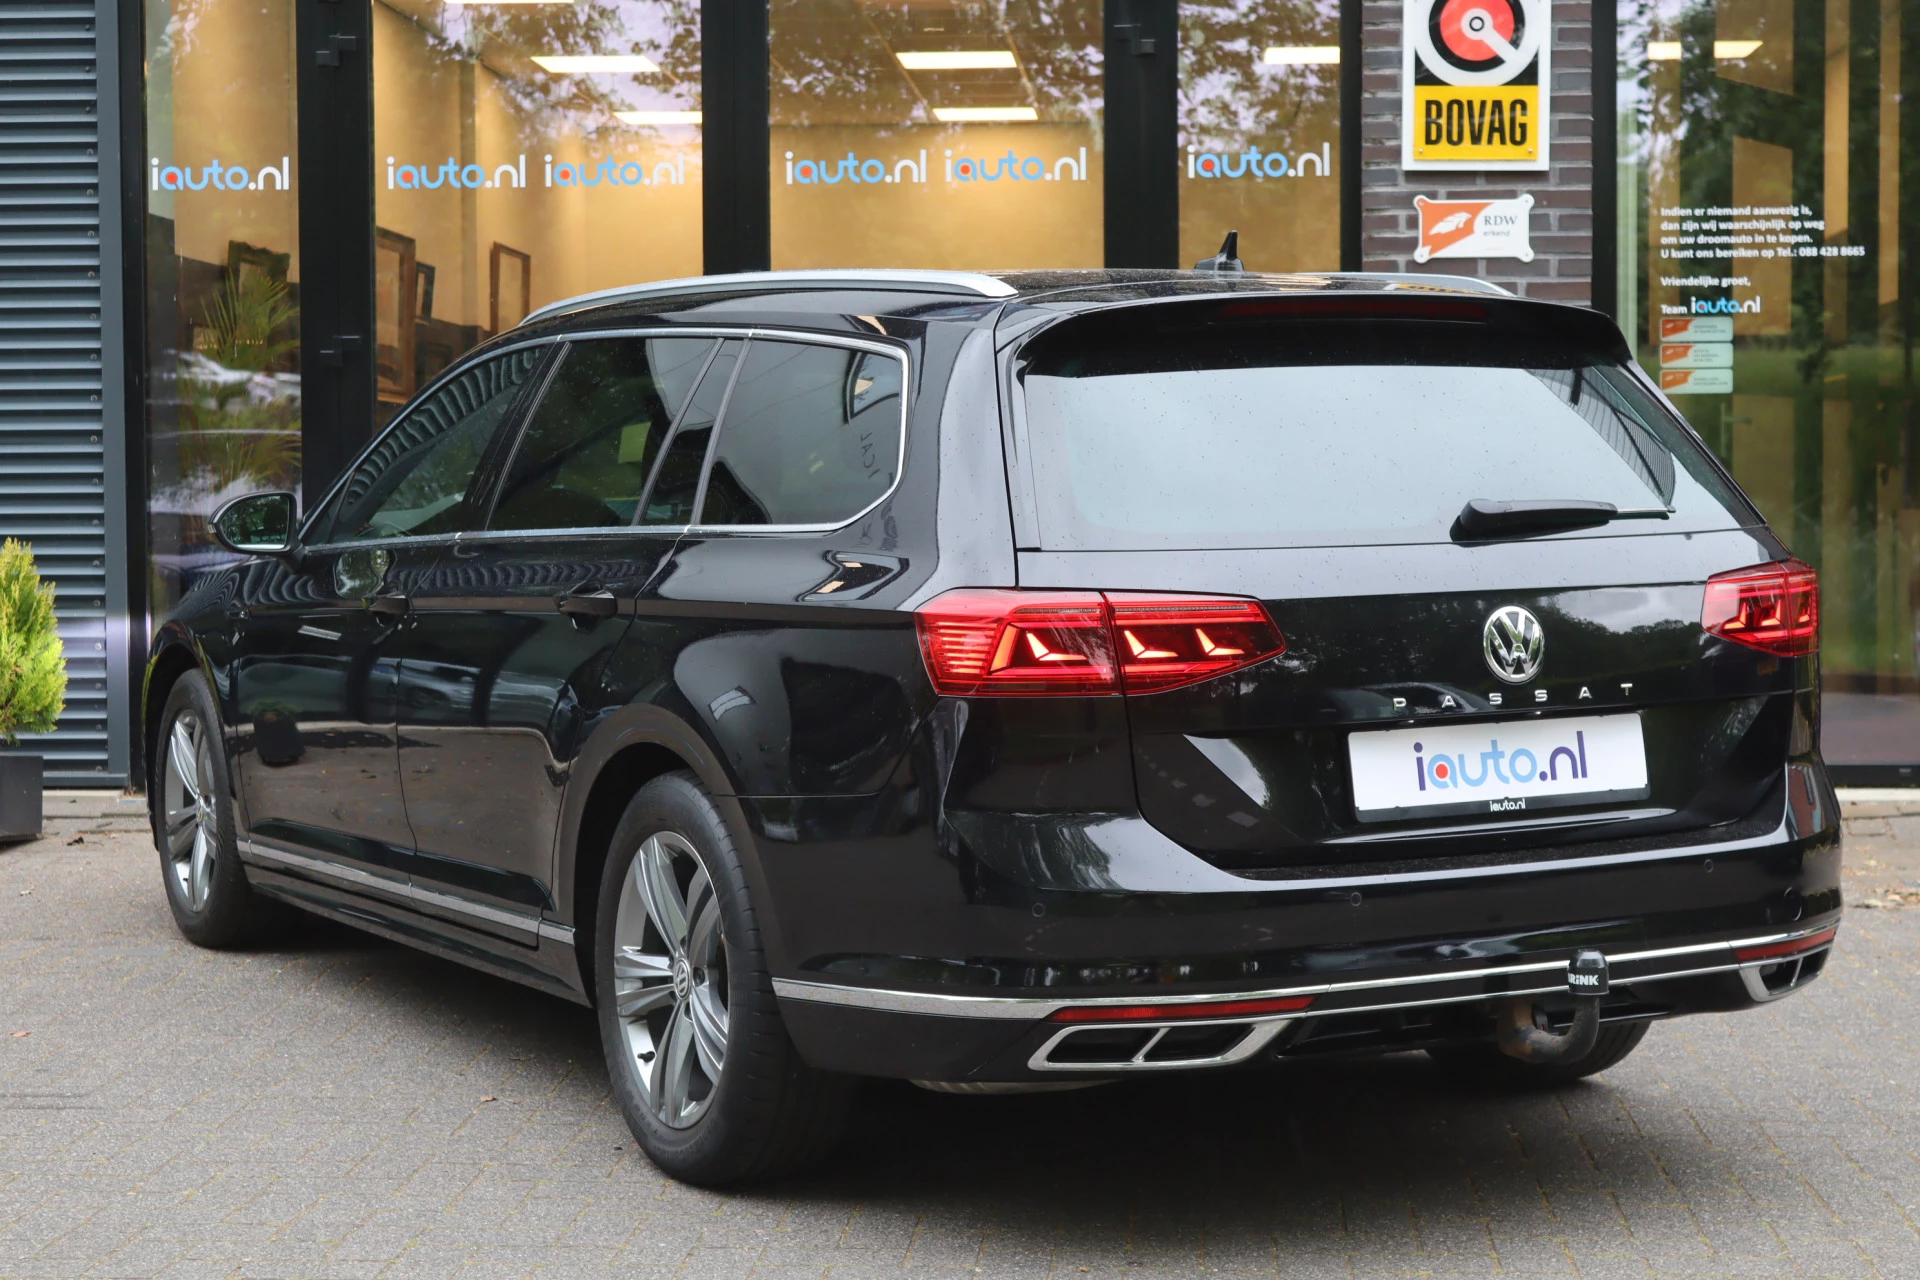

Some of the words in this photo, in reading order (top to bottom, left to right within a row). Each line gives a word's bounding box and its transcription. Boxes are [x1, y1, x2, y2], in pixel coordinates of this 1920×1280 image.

[1425, 99, 1528, 146] BOVAG
[544, 153, 684, 189] iauto.nl
[784, 149, 928, 185] iauto.nl
[944, 146, 1087, 182] iauto.nl
[1187, 141, 1331, 179] iauto.nl
[151, 156, 291, 191] iauto.nl
[387, 154, 526, 190] iauto.nl
[1483, 215, 1518, 226] RDW
[1660, 206, 1692, 216] Indien
[1694, 207, 1705, 216] er
[1707, 205, 1751, 216] niemand
[1753, 205, 1799, 217] aanwezig
[1801, 204, 1813, 216] is,
[1483, 229, 1511, 237] erkend
[1660, 220, 1680, 231] dan
[1682, 220, 1700, 232] zijn
[1701, 220, 1717, 232] wij
[1718, 219, 1786, 231] waarschijnlijk
[1788, 220, 1802, 231] op
[1803, 220, 1825, 231] weg
[1660, 236, 1678, 244] om
[1680, 236, 1695, 244] uw
[1696, 233, 1753, 244] droomauto
[1754, 233, 1765, 243] in
[1766, 234, 1777, 243] te
[1779, 233, 1813, 244] kopen.
[1660, 248, 1670, 258] U
[1670, 248, 1694, 258] kunt
[1695, 249, 1714, 258] ons
[1715, 247, 1759, 258] bereiken
[1761, 248, 1775, 259] op
[1799, 246, 1818, 257] 088
[1819, 246, 1839, 257] 428
[1840, 246, 1865, 257] 8665
[1660, 276, 1720, 288] Vriendelijke
[1721, 276, 1752, 288] groet,
[1660, 304, 1688, 314] Team
[1690, 295, 1761, 314] iauto.nl
[1393, 683, 1634, 711] PASSAT
[1413, 730, 1589, 791] iauto.nl
[1489, 798, 1526, 812] iauto.nl
